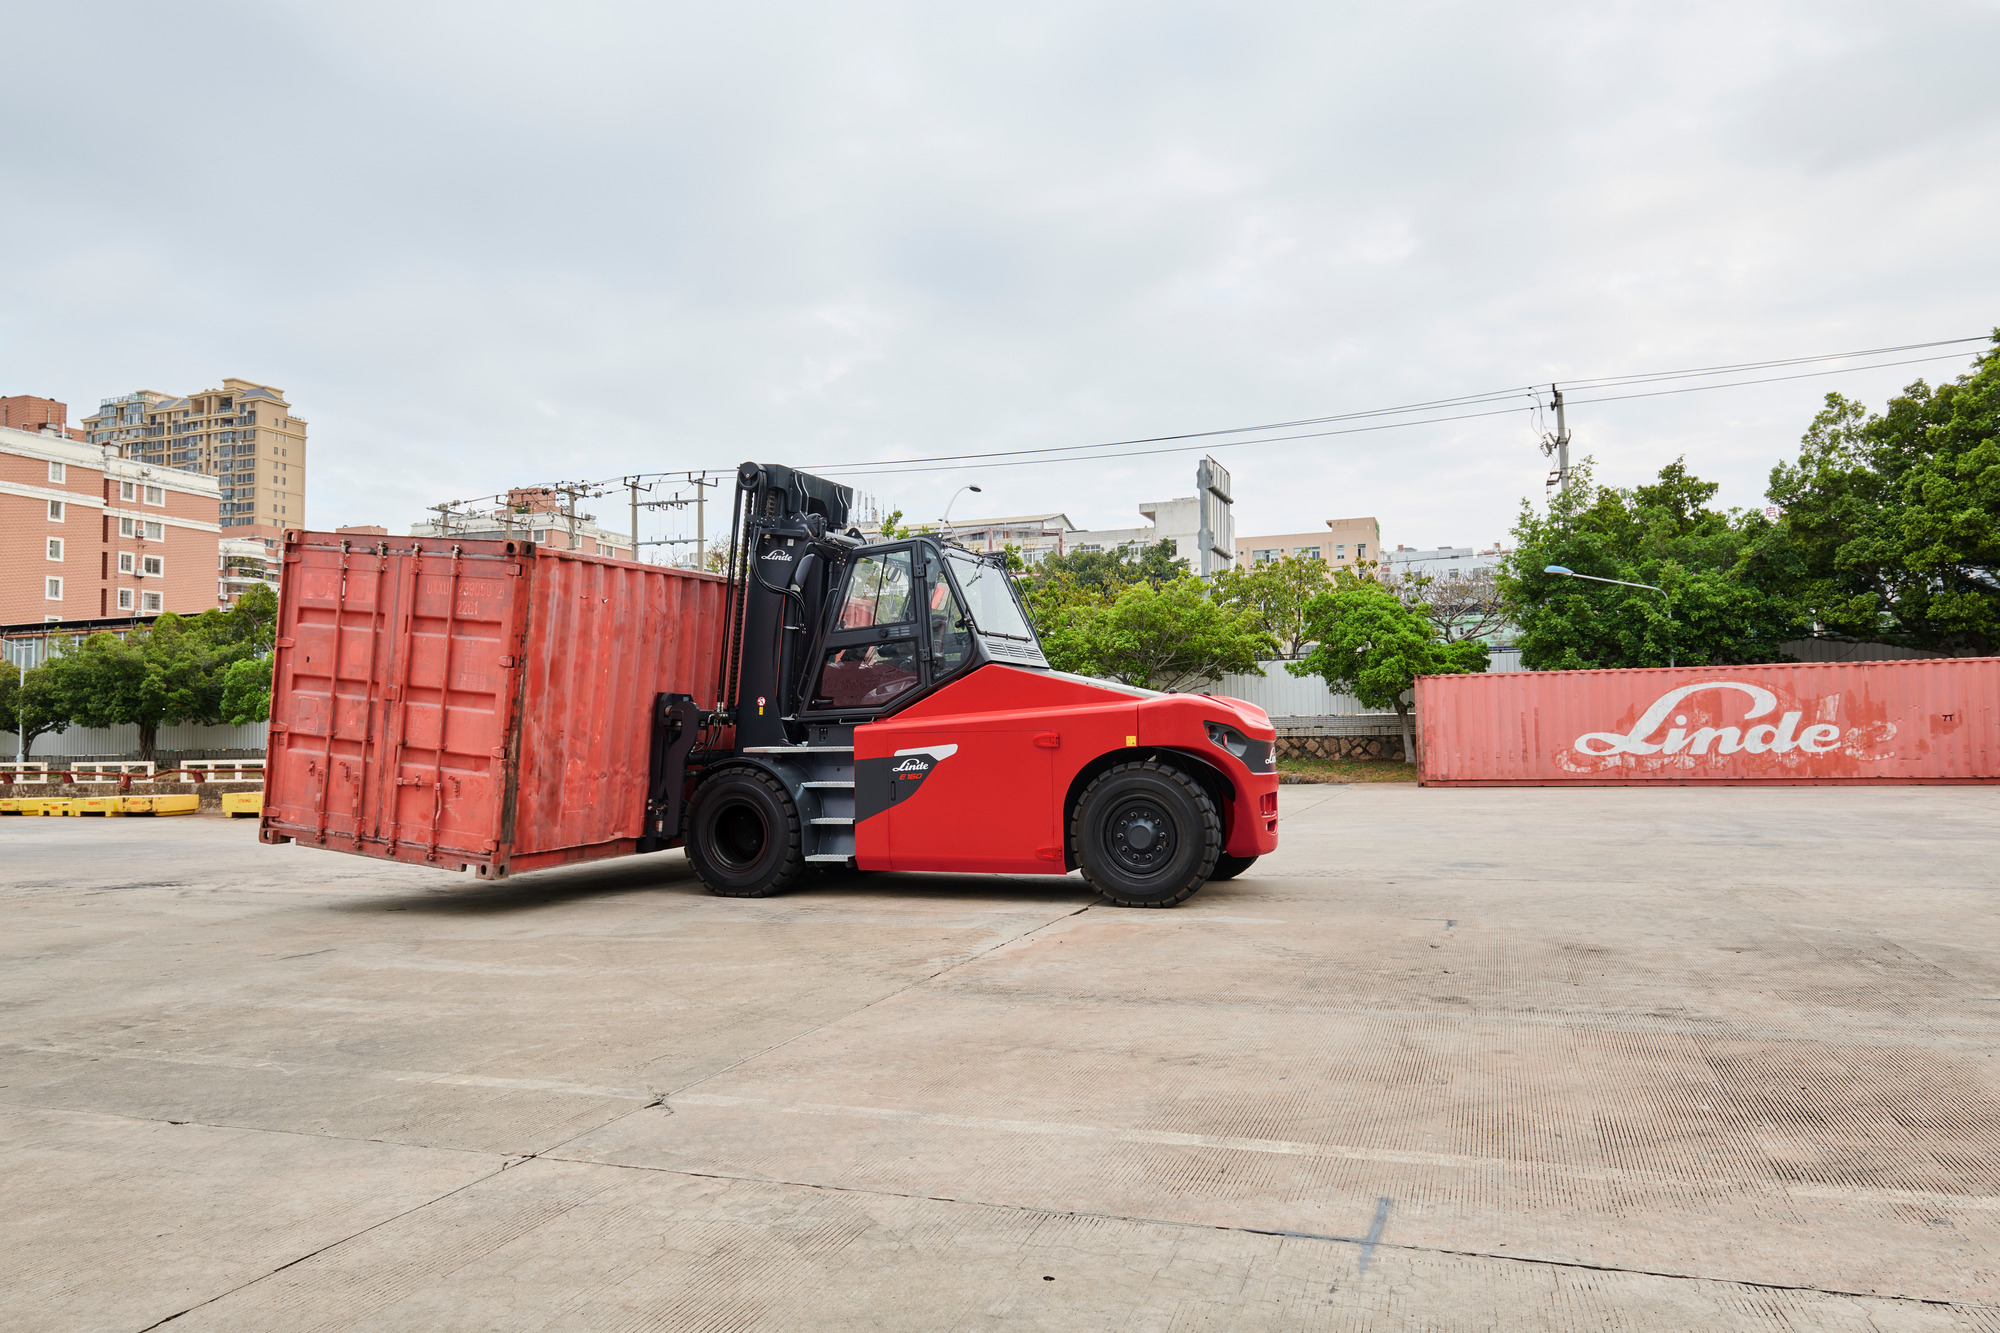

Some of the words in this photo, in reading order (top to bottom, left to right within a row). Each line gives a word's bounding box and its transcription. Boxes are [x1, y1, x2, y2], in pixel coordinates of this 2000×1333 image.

[761, 549, 792, 561] Linde
[1574, 681, 1842, 755] Linde
[892, 758, 929, 772] Linde
